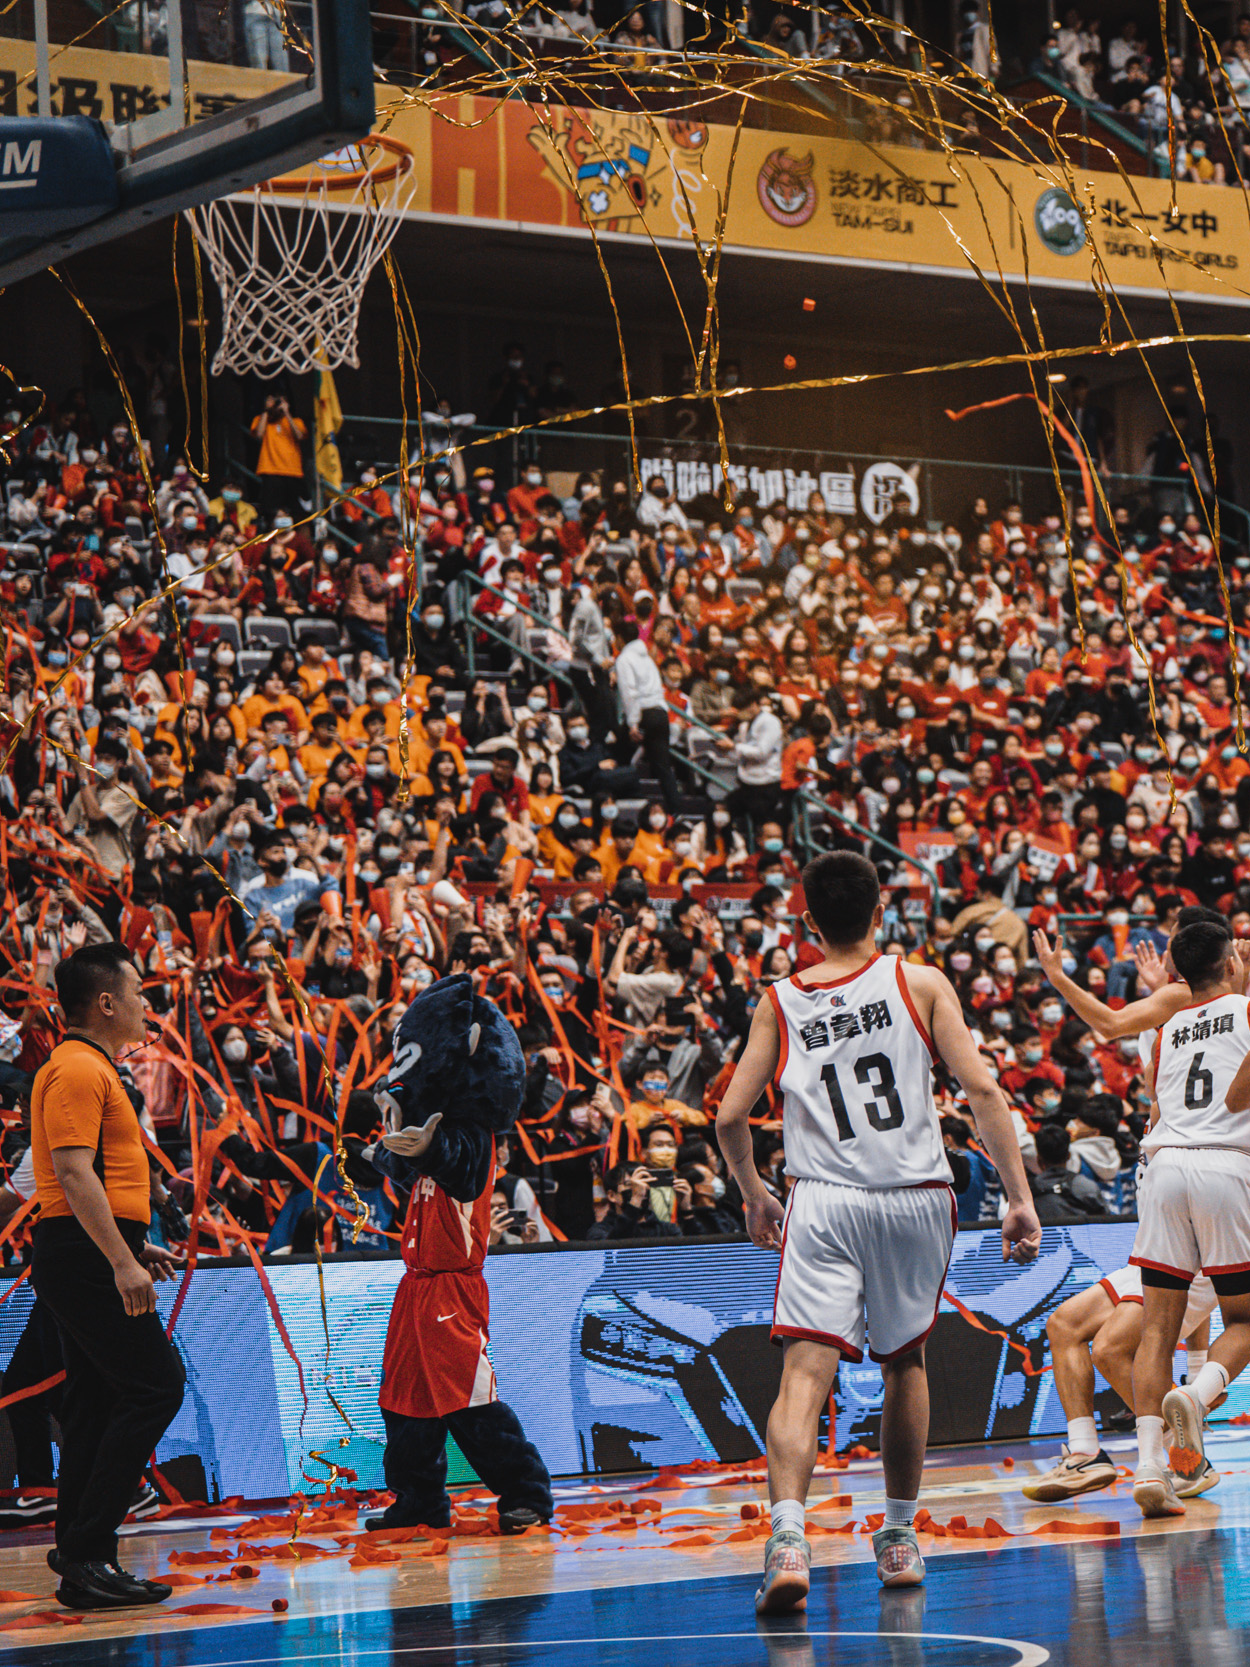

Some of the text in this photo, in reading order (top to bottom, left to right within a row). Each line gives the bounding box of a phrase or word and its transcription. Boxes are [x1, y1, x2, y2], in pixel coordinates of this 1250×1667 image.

[829, 166, 959, 208] 淡水商工
[833, 212, 914, 234] TAM-SUI
[1100, 198, 1218, 238] 北一女中
[820, 1052, 905, 1142] 13
[1184, 1051, 1213, 1111] 6
